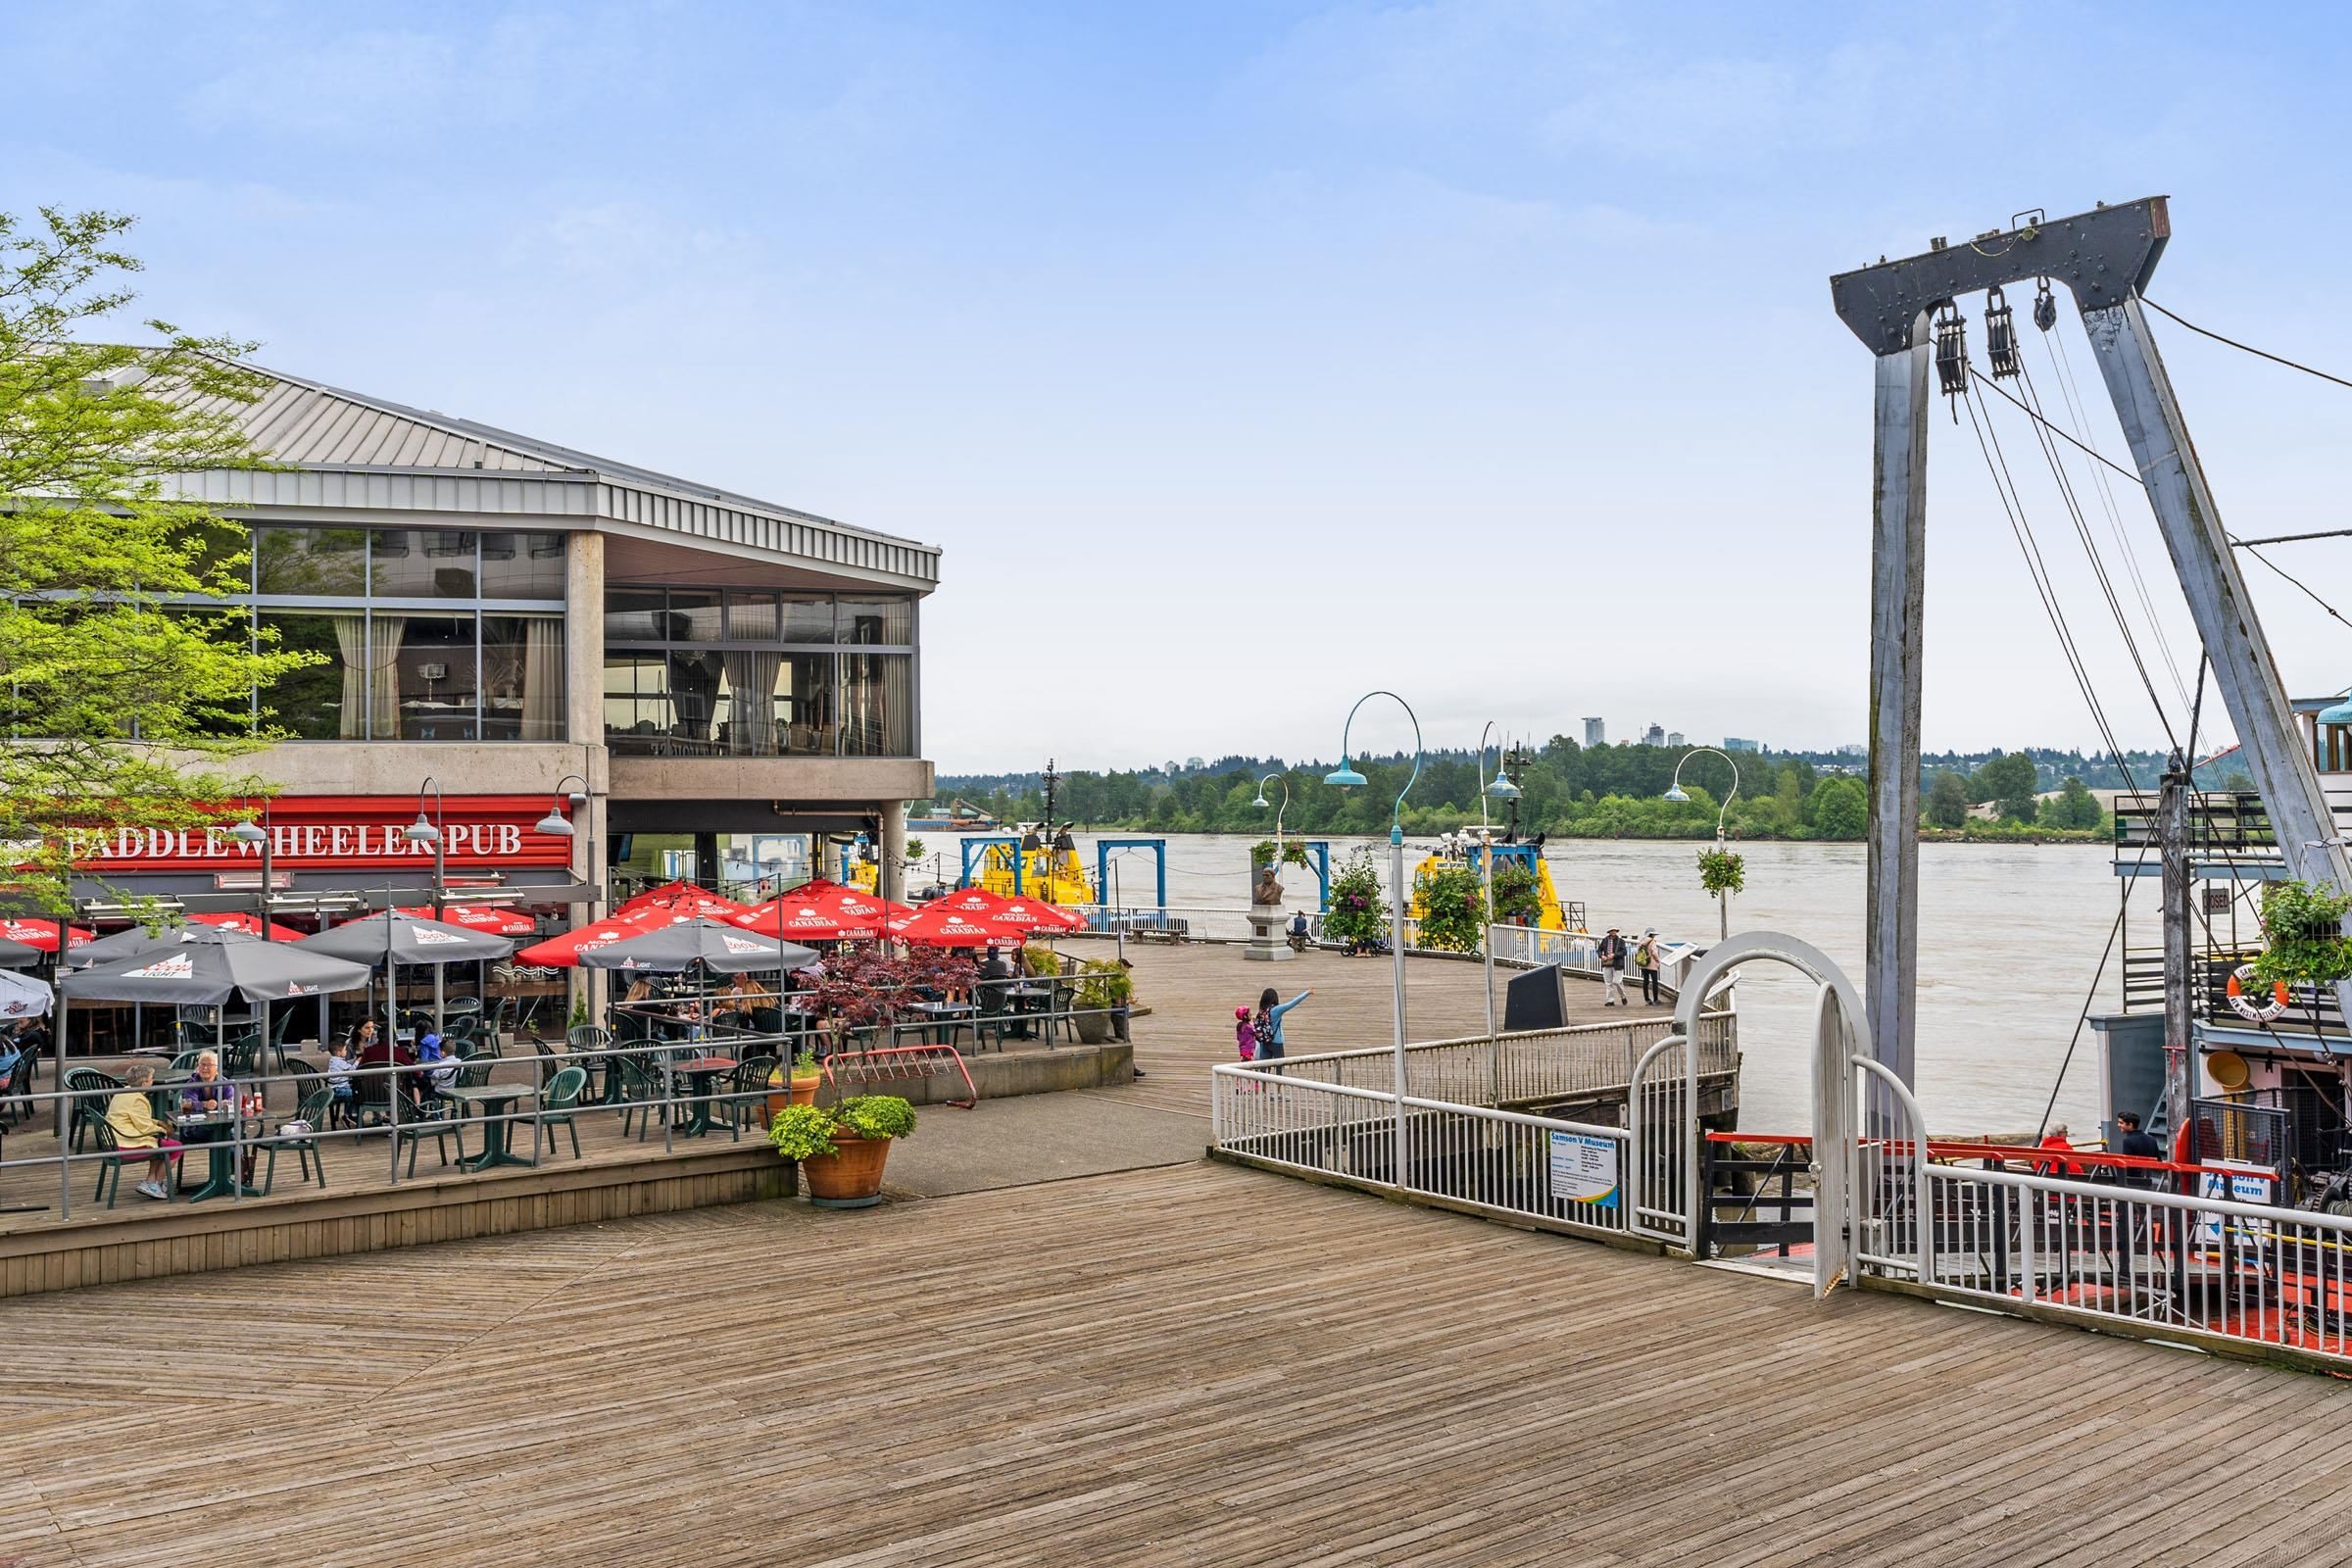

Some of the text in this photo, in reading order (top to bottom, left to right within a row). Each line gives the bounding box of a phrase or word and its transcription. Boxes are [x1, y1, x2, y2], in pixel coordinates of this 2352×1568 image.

[446, 824, 521, 855] PUB
[2203, 894, 2229, 909] COSED
[789, 919, 839, 928] CANADIAN
[992, 914, 1038, 923] CANADIAN
[939, 926, 988, 935] CANADIAN
[994, 937, 1021, 947] CANADIAN
[304, 984, 319, 993] LIGHT
[2230, 997, 2240, 1008] NEW
[1551, 1133, 1577, 1144] Samson
[1585, 1138, 1615, 1149] Museum
